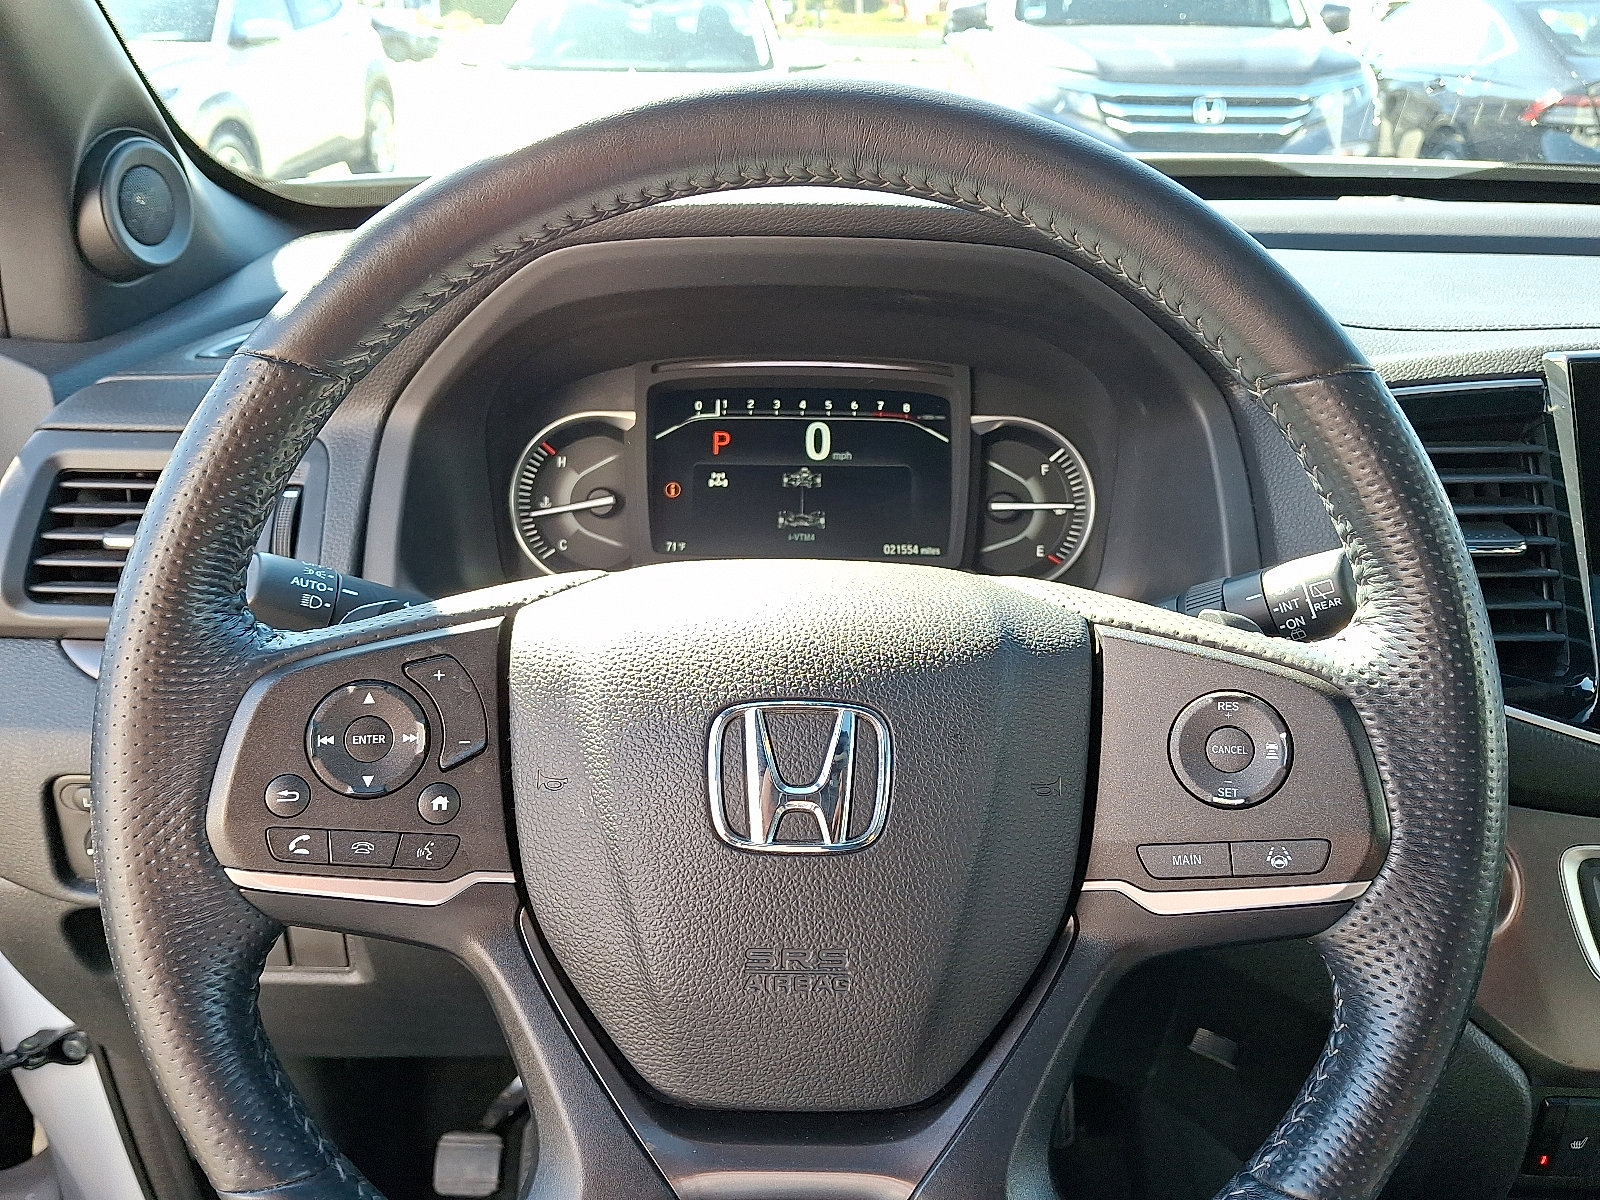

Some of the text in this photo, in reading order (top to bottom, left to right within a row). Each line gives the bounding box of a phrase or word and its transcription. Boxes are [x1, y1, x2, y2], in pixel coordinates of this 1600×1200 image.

[694, 399, 911, 413] 0 1 2 3 4 5 6 7 8
[712, 430, 731, 455] P
[805, 421, 853, 461] 0 mph
[556, 455, 567, 468] H
[1040, 463, 1050, 476] F
[559, 539, 568, 551] C
[882, 543, 941, 556] 021554 miles
[1035, 544, 1046, 558] E
[1314, 597, 1343, 613] REAR
[1217, 701, 1240, 712] RES
[351, 734, 387, 745] ENTER
[1211, 744, 1249, 756] CANCEL
[1217, 787, 1240, 799] SET
[1171, 854, 1203, 867] MAIN
[744, 947, 850, 971] SRS
[742, 975, 851, 992] AIRBAG
